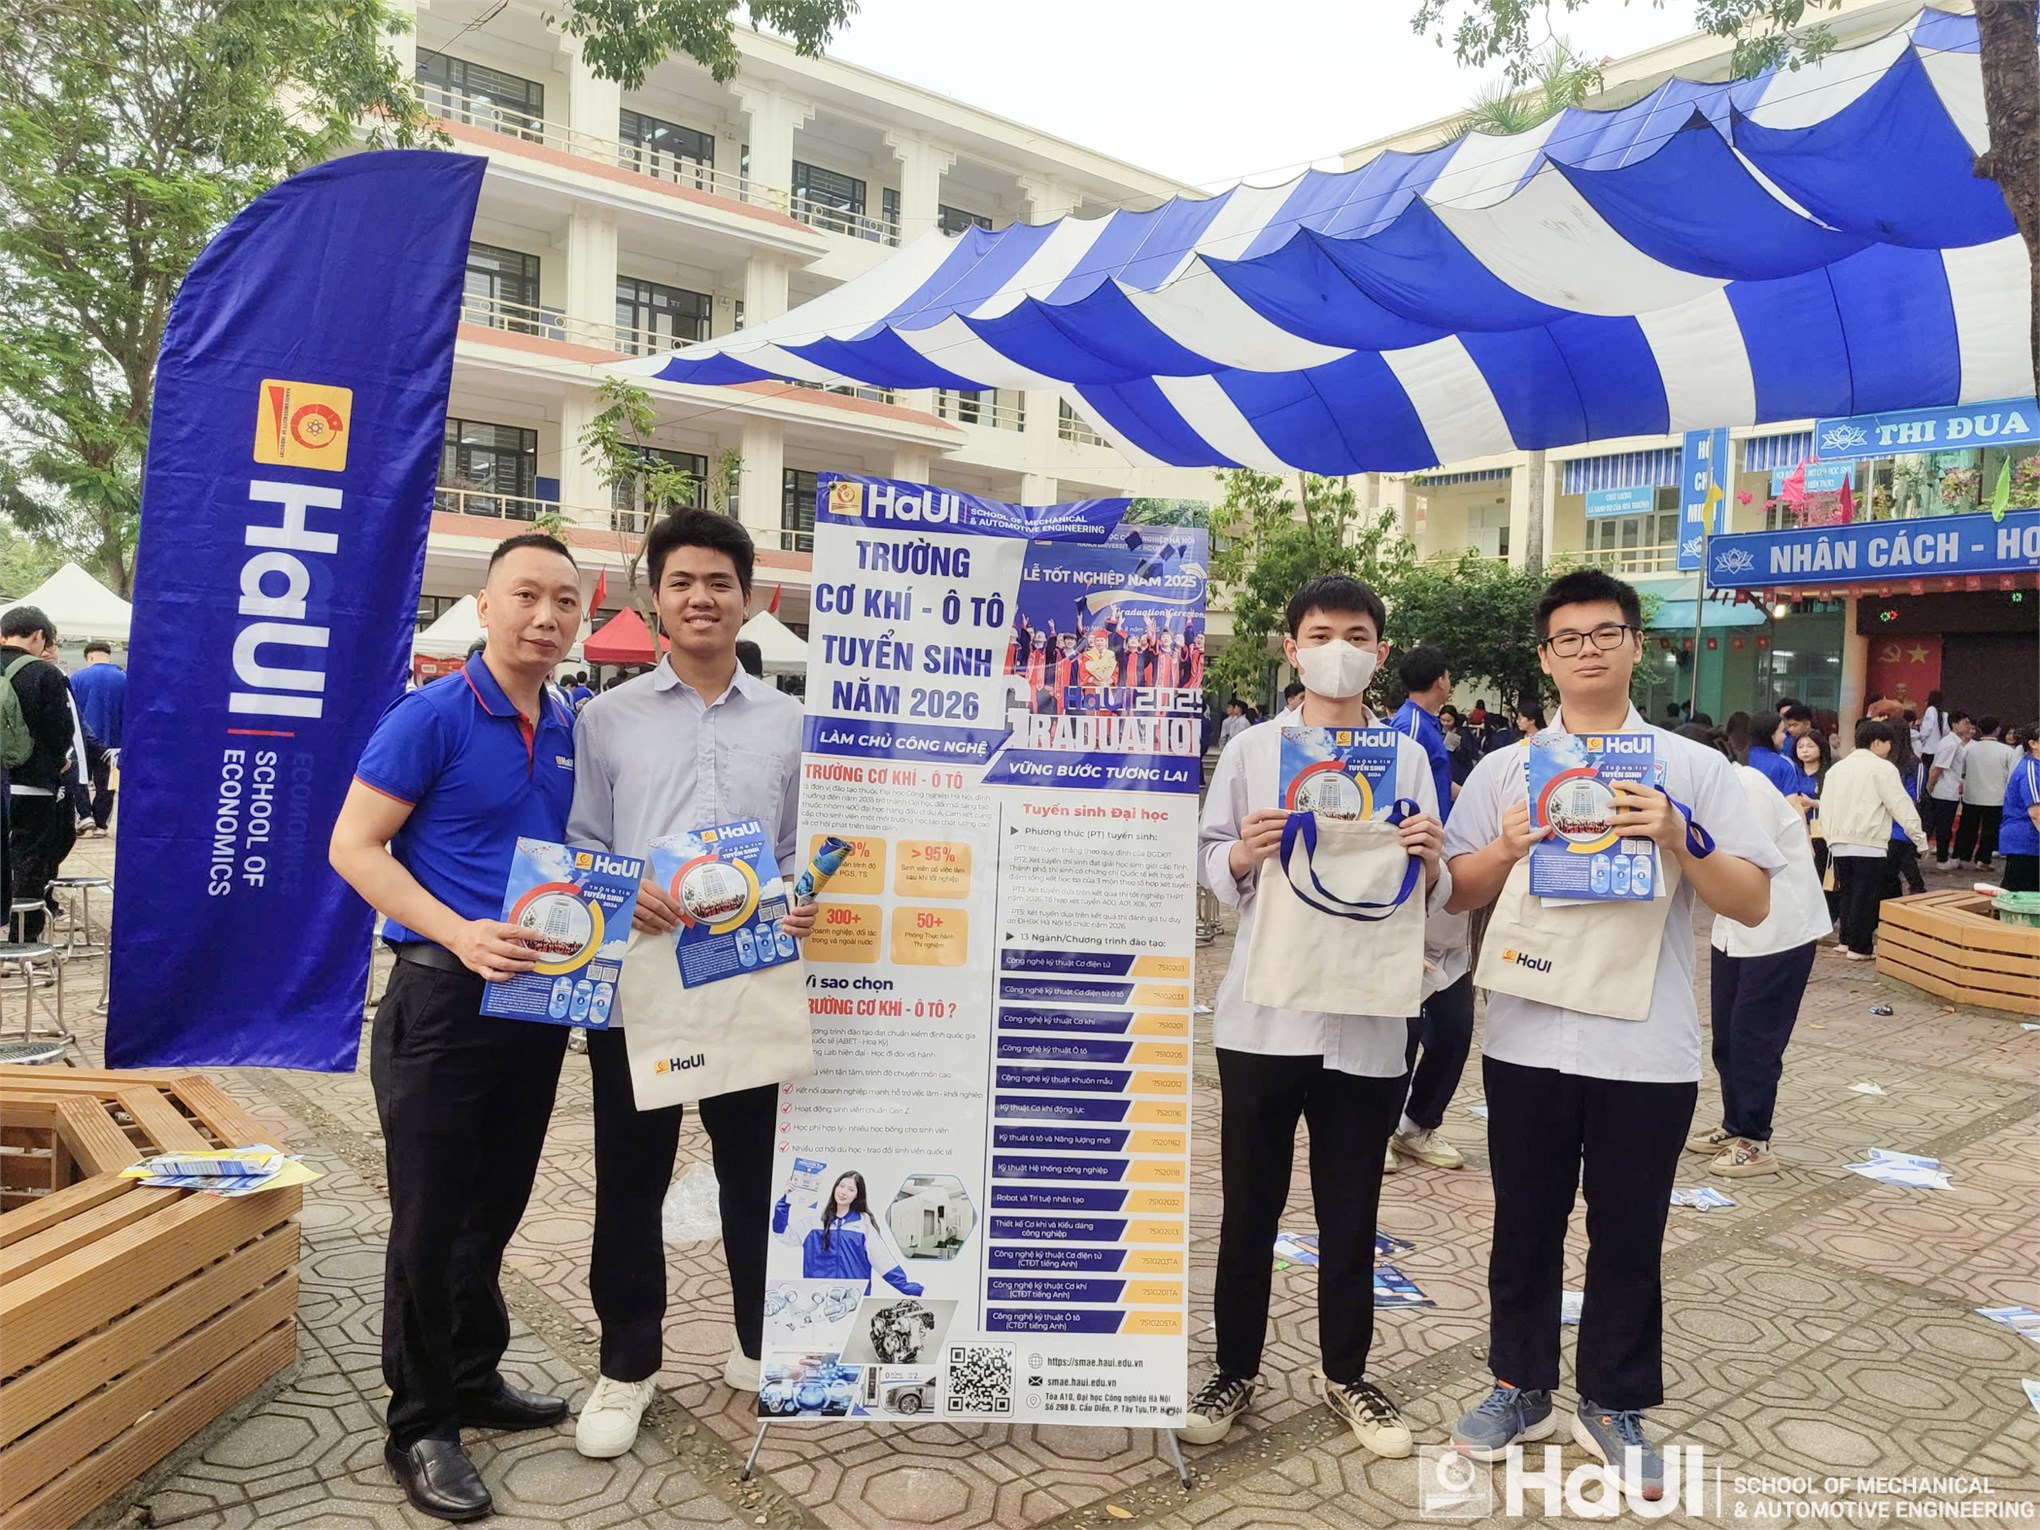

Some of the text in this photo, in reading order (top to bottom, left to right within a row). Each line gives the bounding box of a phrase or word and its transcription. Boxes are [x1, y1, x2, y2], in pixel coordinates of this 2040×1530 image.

[1876, 411, 2030, 446] THI ĐUA
[868, 484, 959, 523] HaUI
[971, 508, 1087, 525] SCHOOL OF MECHANICAL
[979, 518, 1039, 533] AUTOMOTIVE
[1043, 524, 1105, 534] ENGINEERING
[856, 538, 970, 578] TRƯỜNG
[1770, 536, 1857, 575] NHÂN
[1868, 531, 1959, 566] CÁCH
[1024, 563, 1040, 581] LỄ
[1043, 566, 1070, 583] TỐT
[1073, 570, 1124, 588] NGHIỆP
[1164, 575, 1197, 588] 2025
[228, 480, 343, 718] HaUI
[816, 583, 855, 615] CƠ
[864, 586, 913, 621] KHÍ
[943, 589, 960, 625] Ô
[971, 592, 1004, 628] TÔ
[823, 629, 992, 677] TUYỂN SINH
[832, 676, 979, 720] NĂM 2026
[1064, 686, 1131, 710] HaUI
[820, 730, 988, 758] LÀM CHỦ CÔNG NGHỆ
[1354, 731, 1396, 747] HaUI
[1606, 737, 1651, 754] HaUI
[805, 762, 863, 782] TRƯỜNG
[868, 768, 888, 784] CƠ
[892, 768, 916, 786] KHÍ
[932, 770, 940, 788] Ô
[946, 771, 963, 789] TÔ
[1009, 760, 1188, 782] VỮNG BƯỚC TƯƠNG LAI
[208, 749, 245, 896] ECONOMICS
[242, 751, 277, 887] SCHOOL OF
[1023, 802, 1169, 823] Tuyển sinh Đại học
[718, 821, 761, 840] HaUI
[1025, 827, 1158, 841] Phương thức (PT) tuyển sinh:
[925, 846, 955, 862] 95%
[594, 854, 641, 879] HaUI
[827, 908, 861, 924] 300+
[917, 912, 943, 928] 50+
[1032, 934, 1102, 946] Ngành/Chương
[1105, 936, 1127, 946] trình
[1130, 938, 1146, 947] đào
[1006, 956, 1025, 966] Công
[1158, 964, 1185, 972] 7510203
[1516, 952, 1552, 973] HaUI
[820, 978, 849, 990] sao
[853, 976, 894, 993] chọn
[808, 994, 853, 1015] RƯỜNG
[857, 998, 876, 1016] CƠ
[879, 997, 902, 1016] KHÍ
[914, 999, 924, 1018] Ô
[928, 1000, 944, 1018] TÔ
[949, 1002, 957, 1018] ?
[670, 1053, 705, 1072] HaUI
[1148, 1198, 1179, 1206] 75102032
[1047, 1357, 1143, 1368] https://smae.haui.edu.vn
[1047, 1378, 1117, 1387] smae.haui.edu.vn
